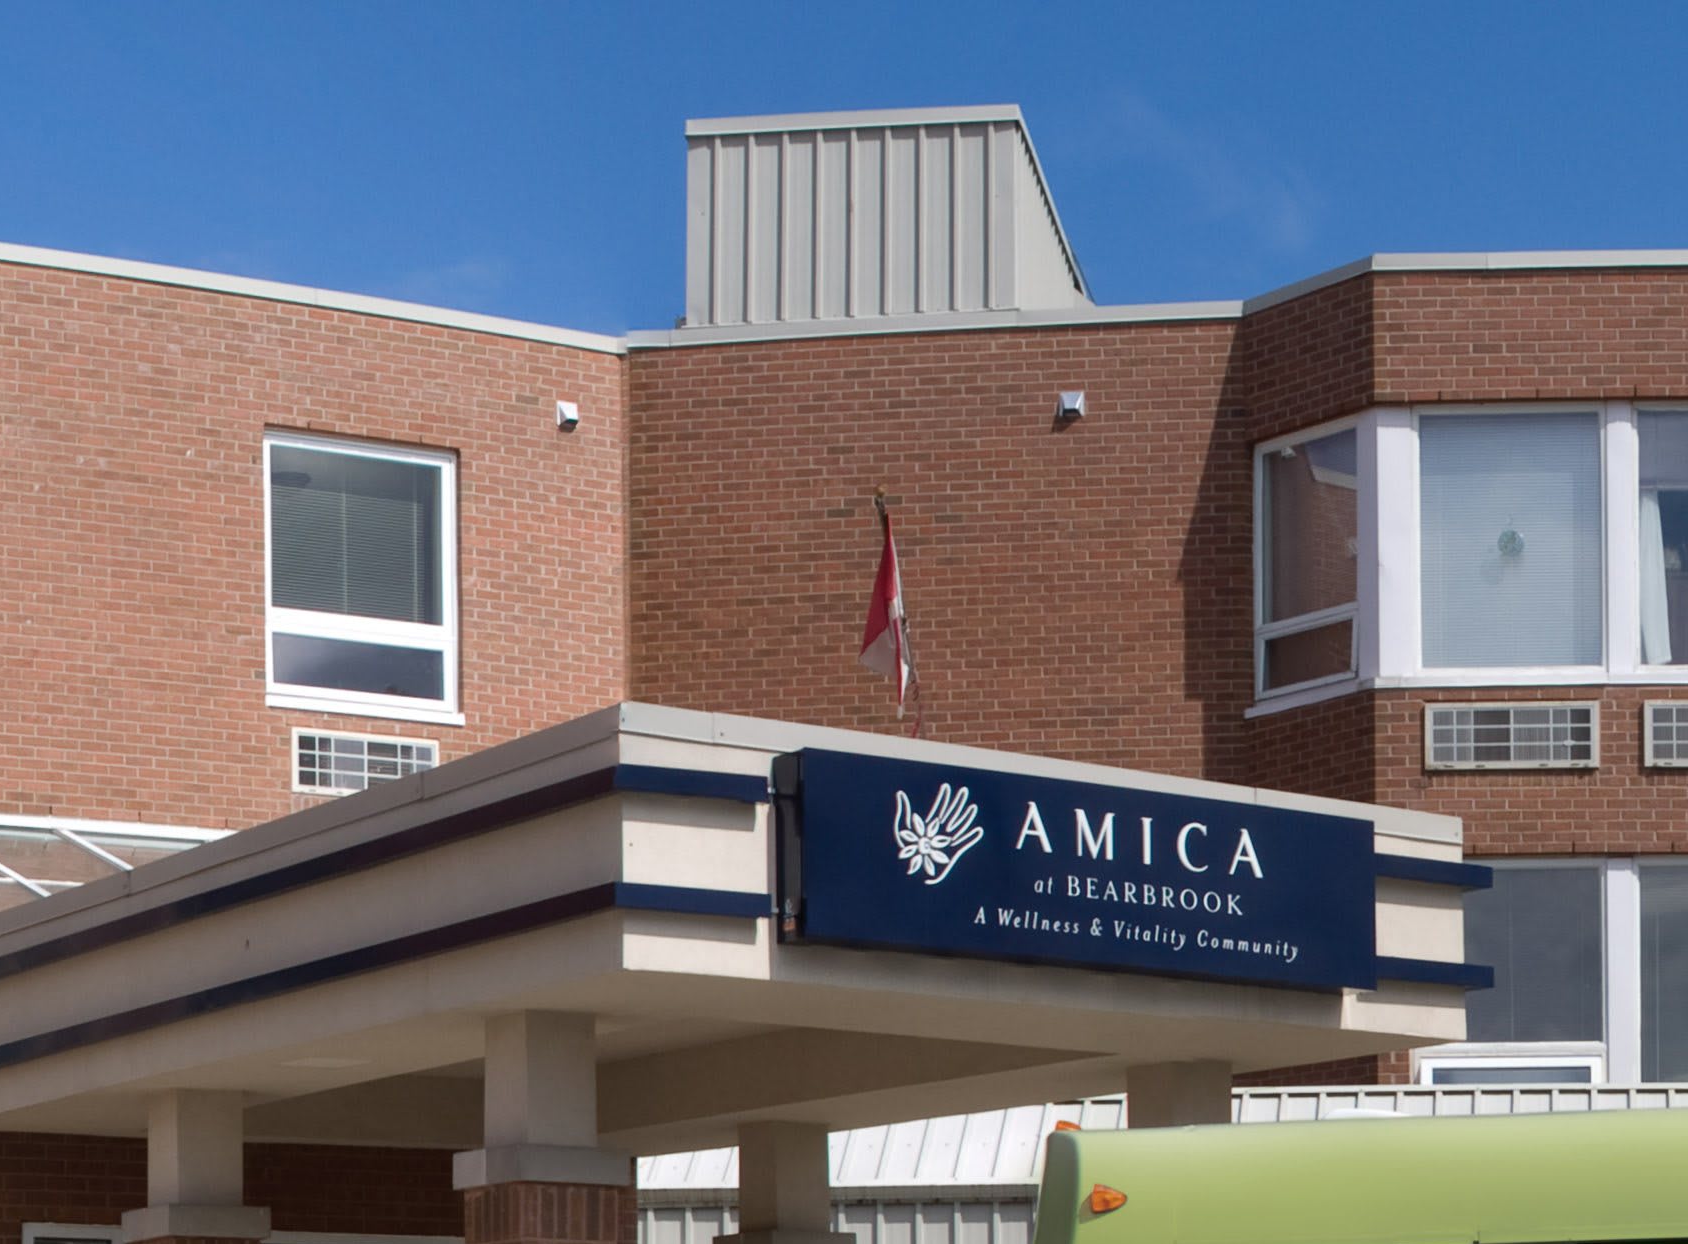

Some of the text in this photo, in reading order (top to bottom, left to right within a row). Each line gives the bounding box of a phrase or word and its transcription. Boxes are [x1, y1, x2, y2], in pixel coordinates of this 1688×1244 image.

[1016, 801, 1264, 879] AMICA
[1034, 875, 1243, 916] at BEARBROOK
[974, 906, 1299, 963] A Wellness & Vitality Community
